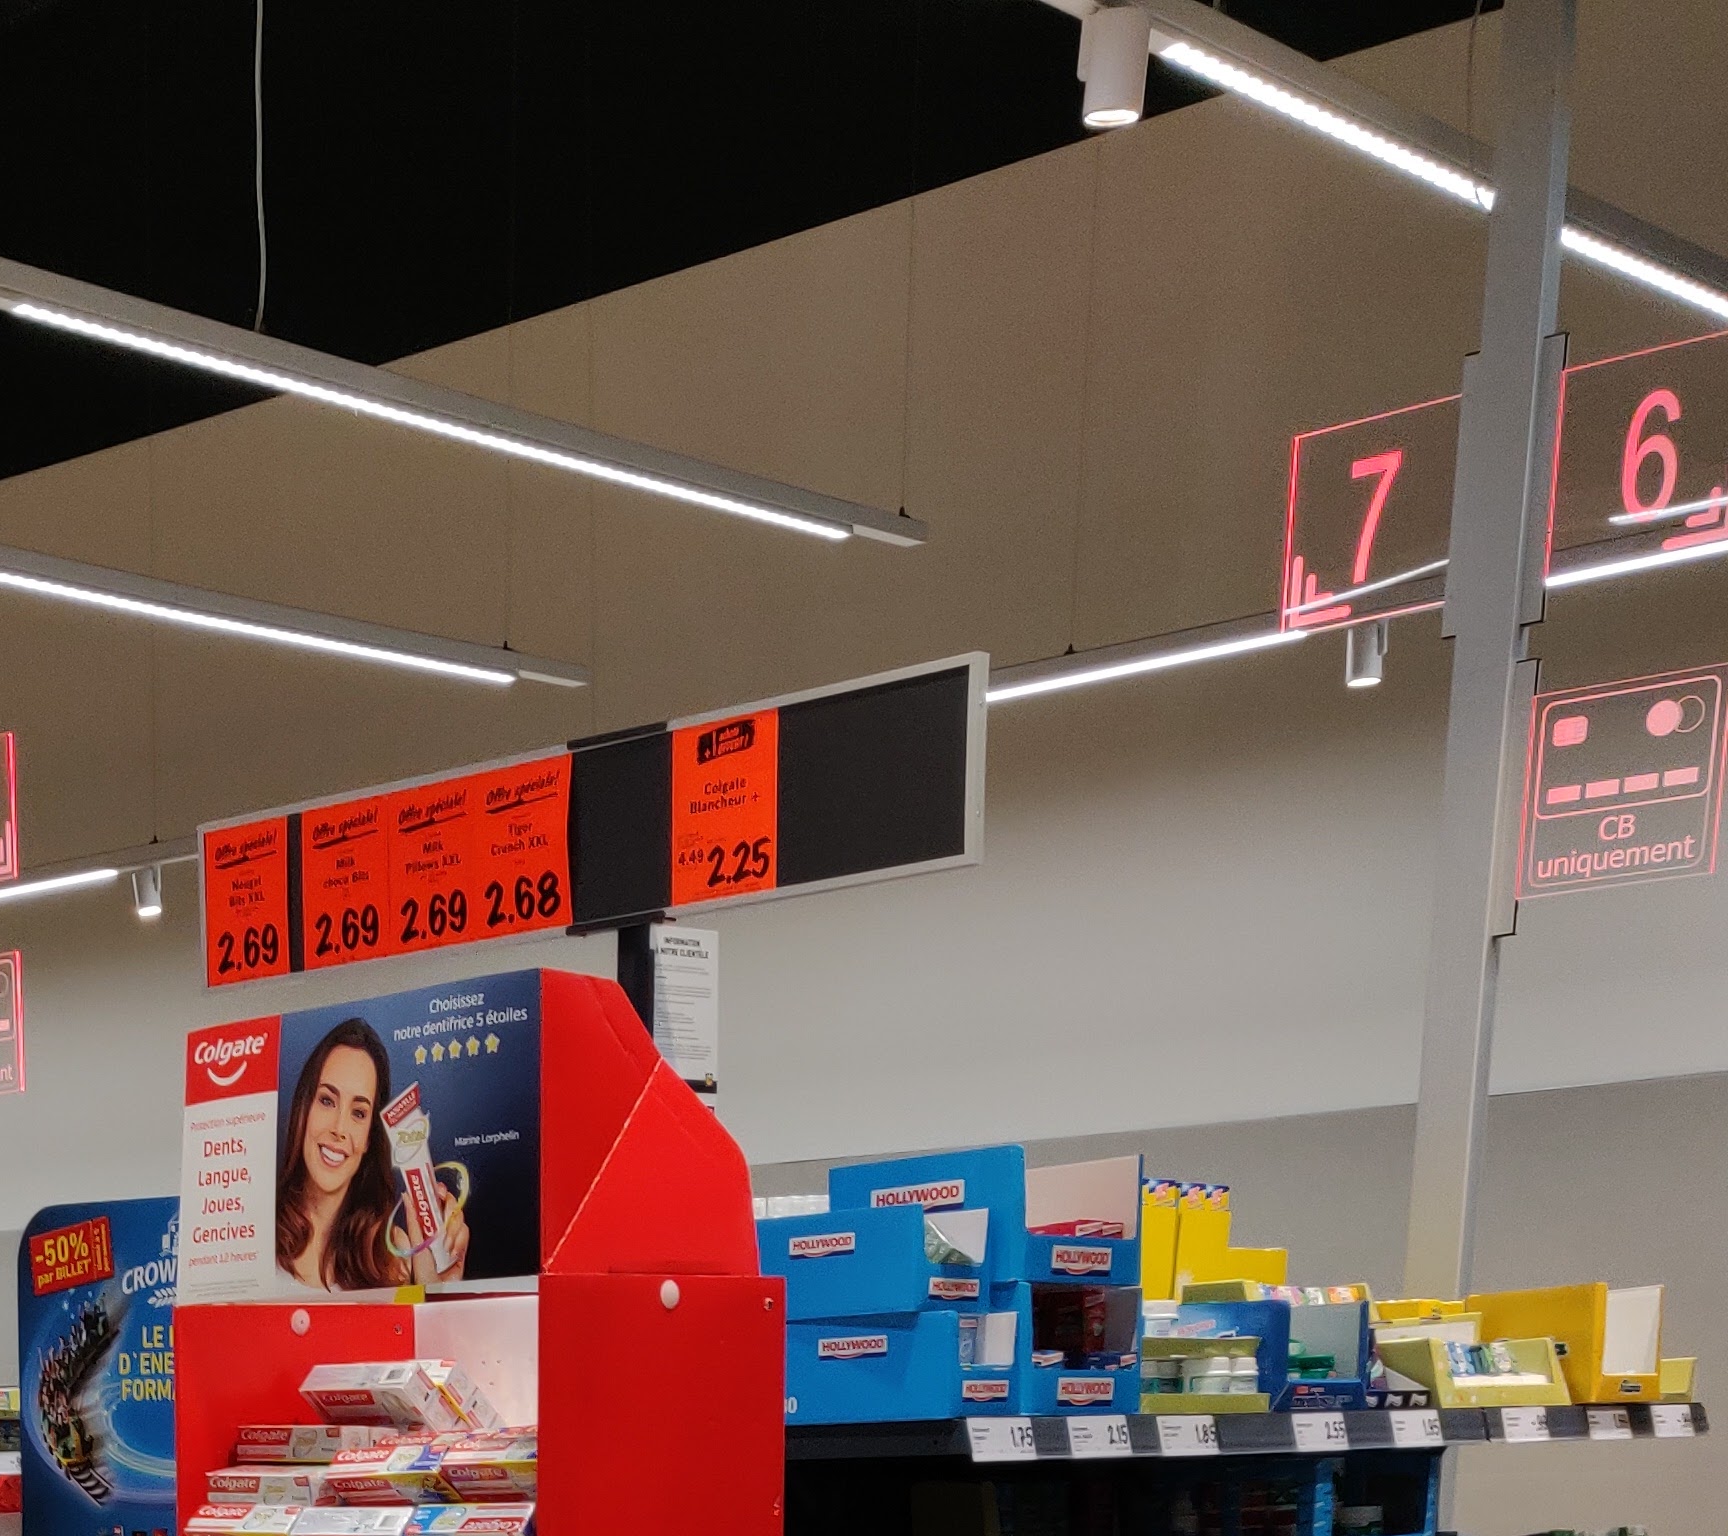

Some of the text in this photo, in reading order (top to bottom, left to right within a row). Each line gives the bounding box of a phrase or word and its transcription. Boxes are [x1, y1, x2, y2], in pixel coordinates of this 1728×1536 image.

[1621, 389, 1681, 523] 6
[1351, 450, 1402, 584] 7
[704, 777, 747, 795] Colgate
[689, 794, 747, 814] Blancheur
[1598, 814, 1636, 842] CB
[491, 840, 525, 856] Crunch
[678, 849, 704, 866] 4.49
[1537, 835, 1696, 882] uniquement
[707, 836, 771, 888] 2.25
[484, 870, 561, 929] 2.68
[400, 889, 467, 944] 2.69
[314, 904, 379, 958] 2.69
[217, 923, 279, 975] 2.69
[429, 992, 485, 1014] Choisissez
[393, 1007, 528, 1041] notre dentifrice 5 étoiles
[194, 1035, 266, 1066] Colgate
[203, 1138, 247, 1158] Dents,
[198, 1166, 252, 1188] Langue,
[202, 1196, 245, 1215] Joues,
[411, 1173, 433, 1237] Colgate
[876, 1185, 959, 1207] HOLLYWOOD
[193, 1222, 256, 1244] Gencives
[35, 1228, 89, 1267] -50%
[1056, 1249, 1109, 1265] HOLLYWOOD
[823, 1338, 885, 1352] HOLLYWOOD
[122, 1378, 175, 1401] FORM
[240, 1427, 289, 1443] Colgate
[337, 1448, 390, 1463] Colgate
[209, 1475, 256, 1491] Colgate
